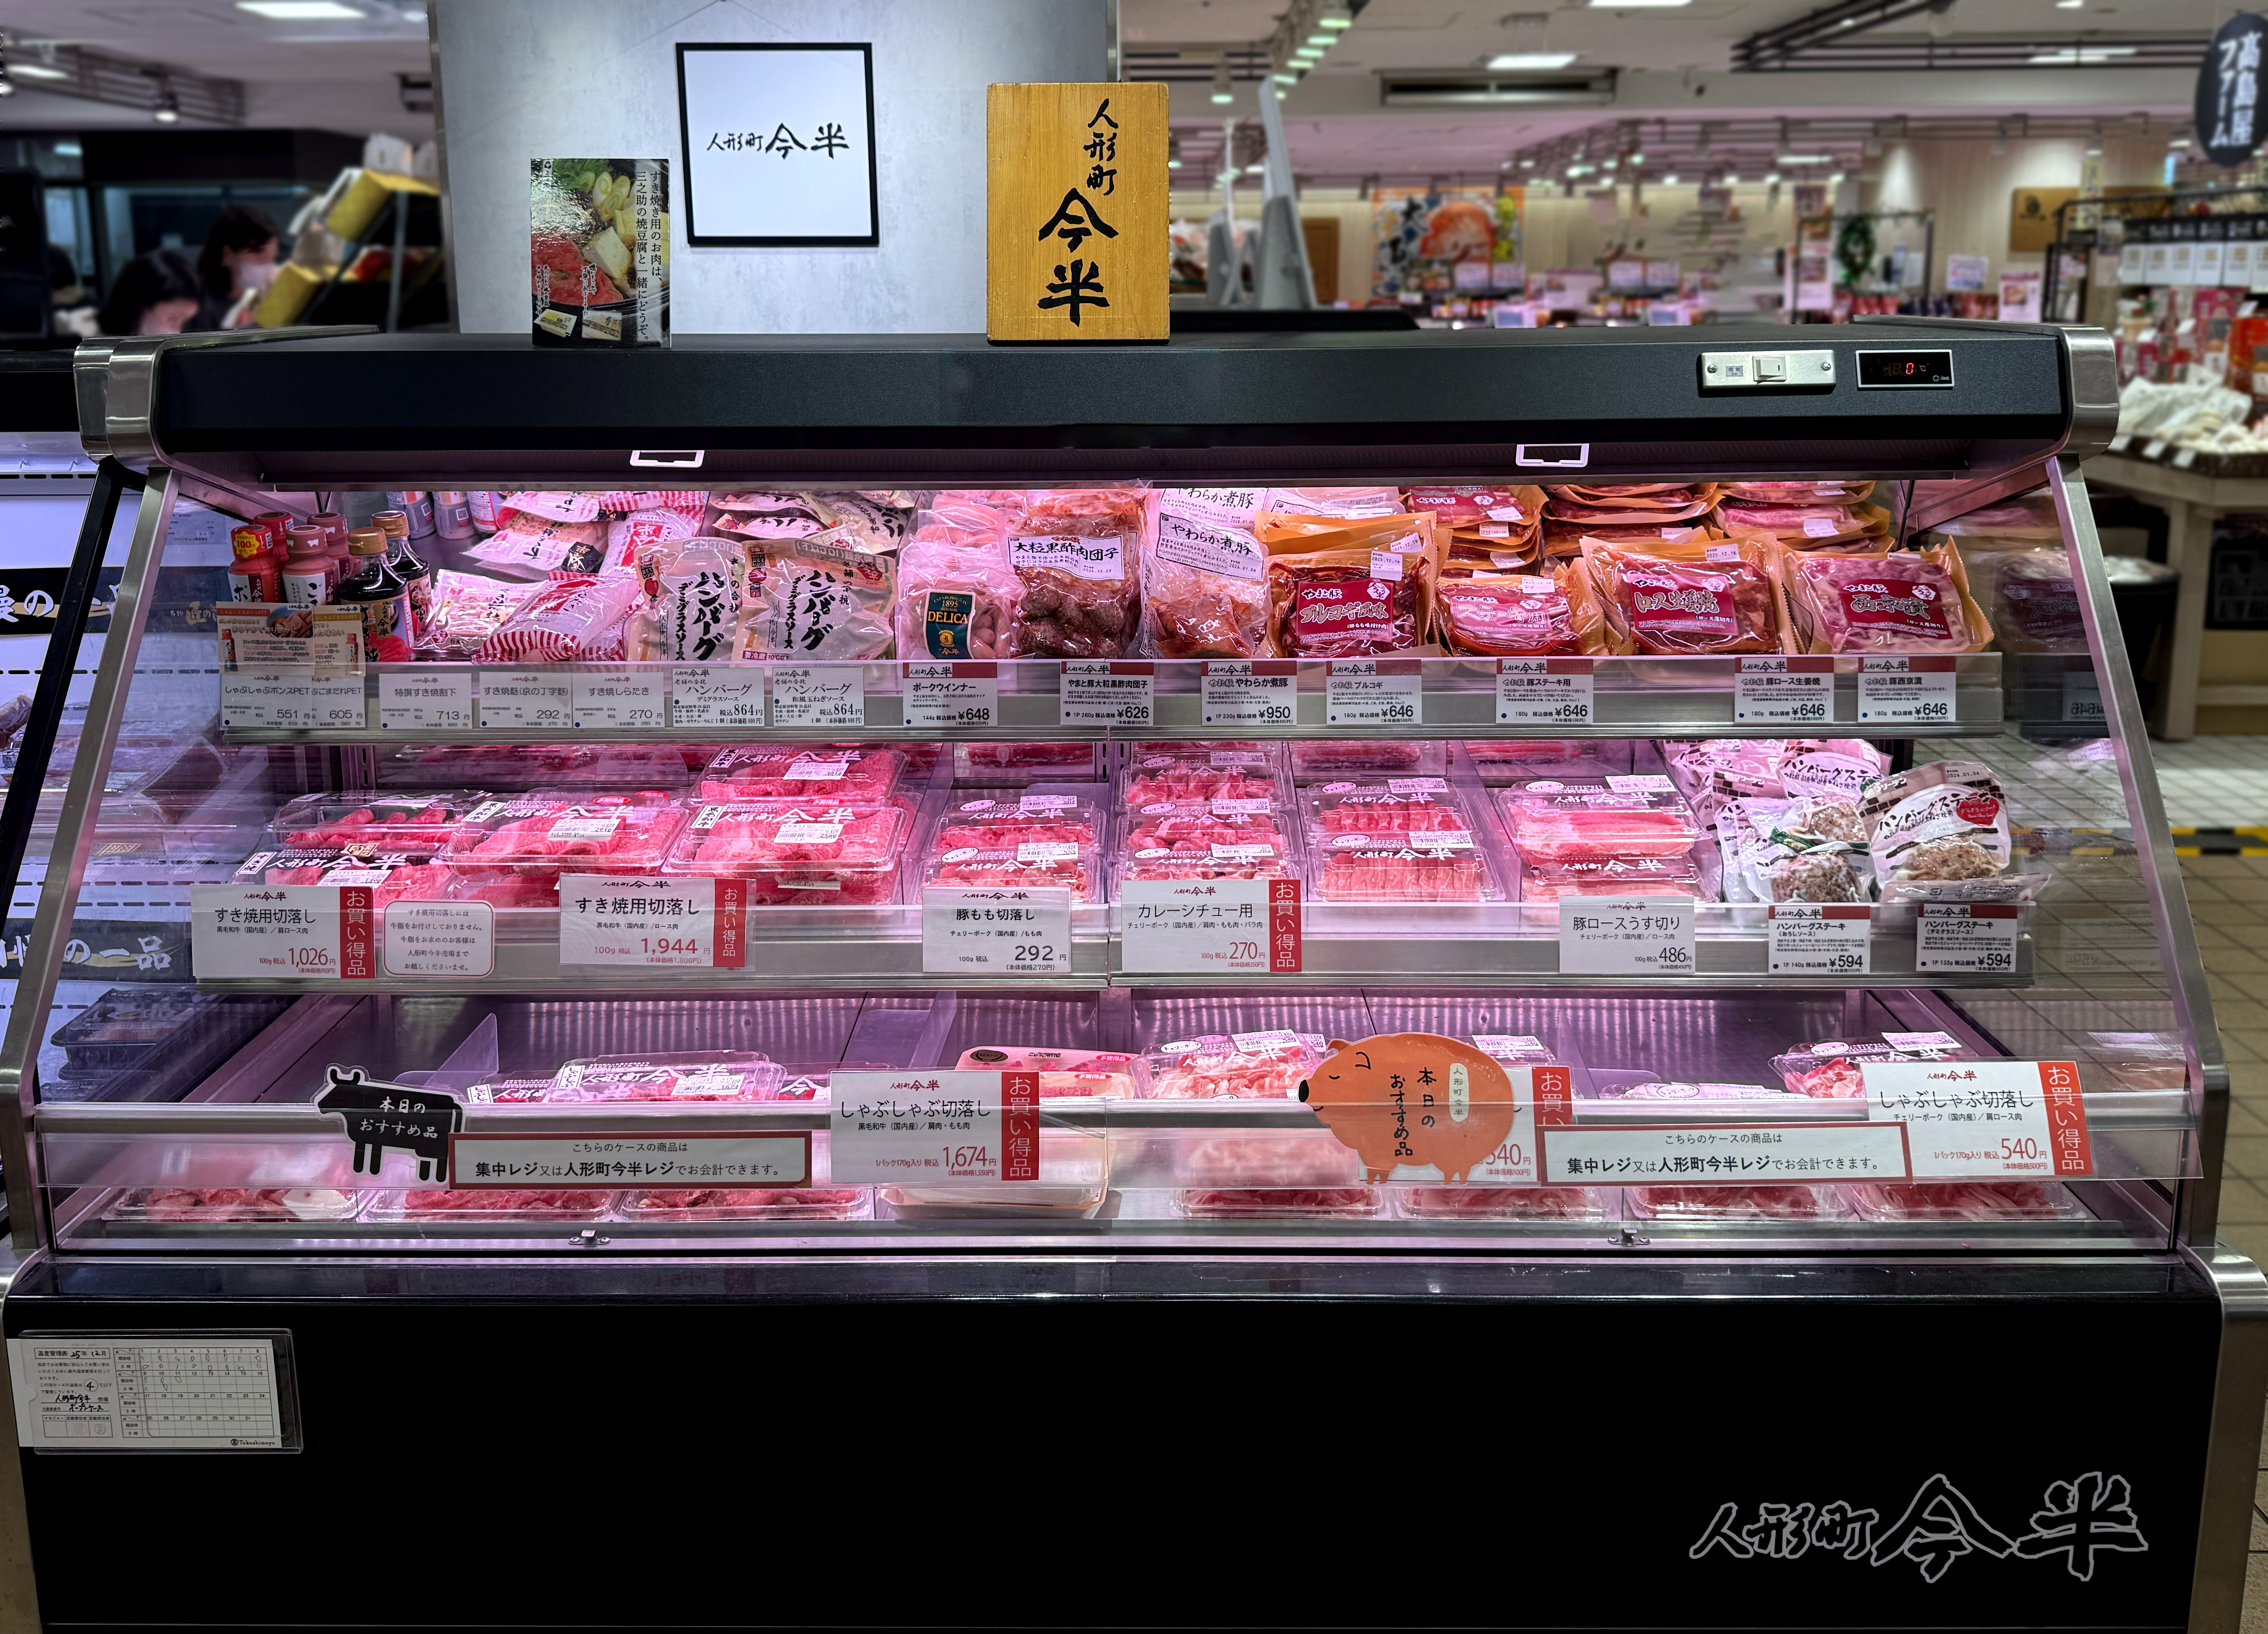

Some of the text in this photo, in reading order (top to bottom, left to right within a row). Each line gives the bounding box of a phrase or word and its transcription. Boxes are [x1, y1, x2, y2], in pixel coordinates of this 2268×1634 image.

[707, 123, 849, 159] 人形町今半
[1037, 99, 1118, 328] 人形町今半
[650, 171, 662, 282] すき焼き用のお肉は、
[636, 171, 649, 340] 三之助の焼豆腐と一緒にどうぞ。
[1172, 524, 1254, 555] やわらか煮豚
[1012, 542, 1119, 561] 大粒黒酢肉団子
[801, 570, 837, 651] ハンバーグ
[1300, 602, 1389, 623] プルコギ風味
[1851, 594, 1930, 619] 西京漬
[692, 572, 726, 661] ハンバーグ
[928, 611, 967, 624] DELICA
[1455, 604, 1546, 623] ステーキ用
[909, 666, 952, 677] 人形町今半
[1066, 665, 1110, 674] 人形町今半
[1208, 665, 1252, 674] 人形町今半
[1333, 664, 1376, 674] 人形町今半
[1503, 663, 1547, 673] 人形町今半
[1742, 661, 1787, 672] 人形町今半
[1863, 660, 1908, 671] 人形町今半
[775, 669, 810, 677] 人形町今半
[1068, 679, 1148, 688] やまと豚大粒黒酢肉団子
[1236, 678, 1288, 687] やわらか煮豚
[1527, 678, 1571, 686] 豚ステーキ用
[1766, 677, 1820, 685] 豚ロース生姜焼
[225, 686, 310, 695] しゃぶしゃぶポンスPET
[588, 687, 649, 696] すき焼しらたき
[686, 684, 753, 695] ハンバーグ
[785, 683, 852, 695] ハンバーグ
[913, 683, 976, 692] ポークウインナー
[277, 710, 297, 718] 551
[330, 710, 352, 719] 605
[537, 710, 560, 719] 292
[629, 710, 652, 719] 270
[958, 708, 990, 720] ¥648
[1117, 707, 1149, 719] ¥626
[1258, 706, 1290, 719] ¥950
[1382, 705, 1413, 717] ¥646
[1555, 705, 1587, 717] ¥646
[1791, 704, 1824, 715] ¥646
[1915, 703, 1947, 715] ¥646
[437, 711, 459, 720] 713
[735, 750, 862, 763] 人形町今半
[717, 808, 856, 824] 人形町今半
[1879, 790, 1991, 831] ハンバーグステーキ
[244, 891, 286, 901] 人形町今半
[1174, 886, 1216, 896] 人形町今半
[575, 897, 700, 915] すき焼用切落し
[1139, 904, 1252, 918] カレーシチュー用
[215, 908, 316, 924] すき焼用切落し
[956, 909, 1034, 920] 豚もも切落し
[1775, 909, 1822, 919] 人形町今半
[1924, 908, 1971, 917] 人形町今半
[391, 922, 482, 930] 牛脂をお付けしておりません。
[723, 888, 737, 957] お買い得品
[1275, 882, 1295, 968] お買い得品
[1573, 917, 1680, 930] 豚ロースうす切り
[1776, 922, 1846, 931] ハンバーグステーキ
[1925, 920, 1994, 929] ハンバーグステーキ
[346, 891, 366, 975] お買い得品
[594, 947, 615, 955] 100g
[641, 939, 698, 955] 1,944
[1015, 945, 1053, 961] 292
[1829, 955, 1863, 968] ¥594
[1978, 953, 2012, 966] ¥594
[1927, 1070, 1977, 1081] 人形町今半
[890, 1080, 940, 1091] 人形町今半
[1453, 1067, 1464, 1116] 人形町今半
[1417, 1067, 1437, 1128] 本日の
[1879, 1090, 2034, 1108] しゃぶしゃぶ切落し
[379, 1098, 426, 1115] 本日の
[841, 1100, 990, 1118] しゃぶしゃぶ切落し
[1390, 1074, 1413, 1156] おすすめ品
[2047, 1066, 2084, 1171] お買い得品
[360, 1118, 438, 1138] おすすめ品
[1009, 1076, 1032, 1177] お買い得品
[1665, 1133, 1782, 1144] こちらのケースの商品は
[573, 1143, 688, 1152] こちらのケースの商品は
[475, 1161, 779, 1177] 集中レジ又は人形町今半レジでお会計できます。
[1567, 1156, 1879, 1174] 集中レジ又は人形町今半レジでお会計できます。
[86, 1381, 94, 1391] 4
[1689, 1471, 2149, 1583] 人形町今半
